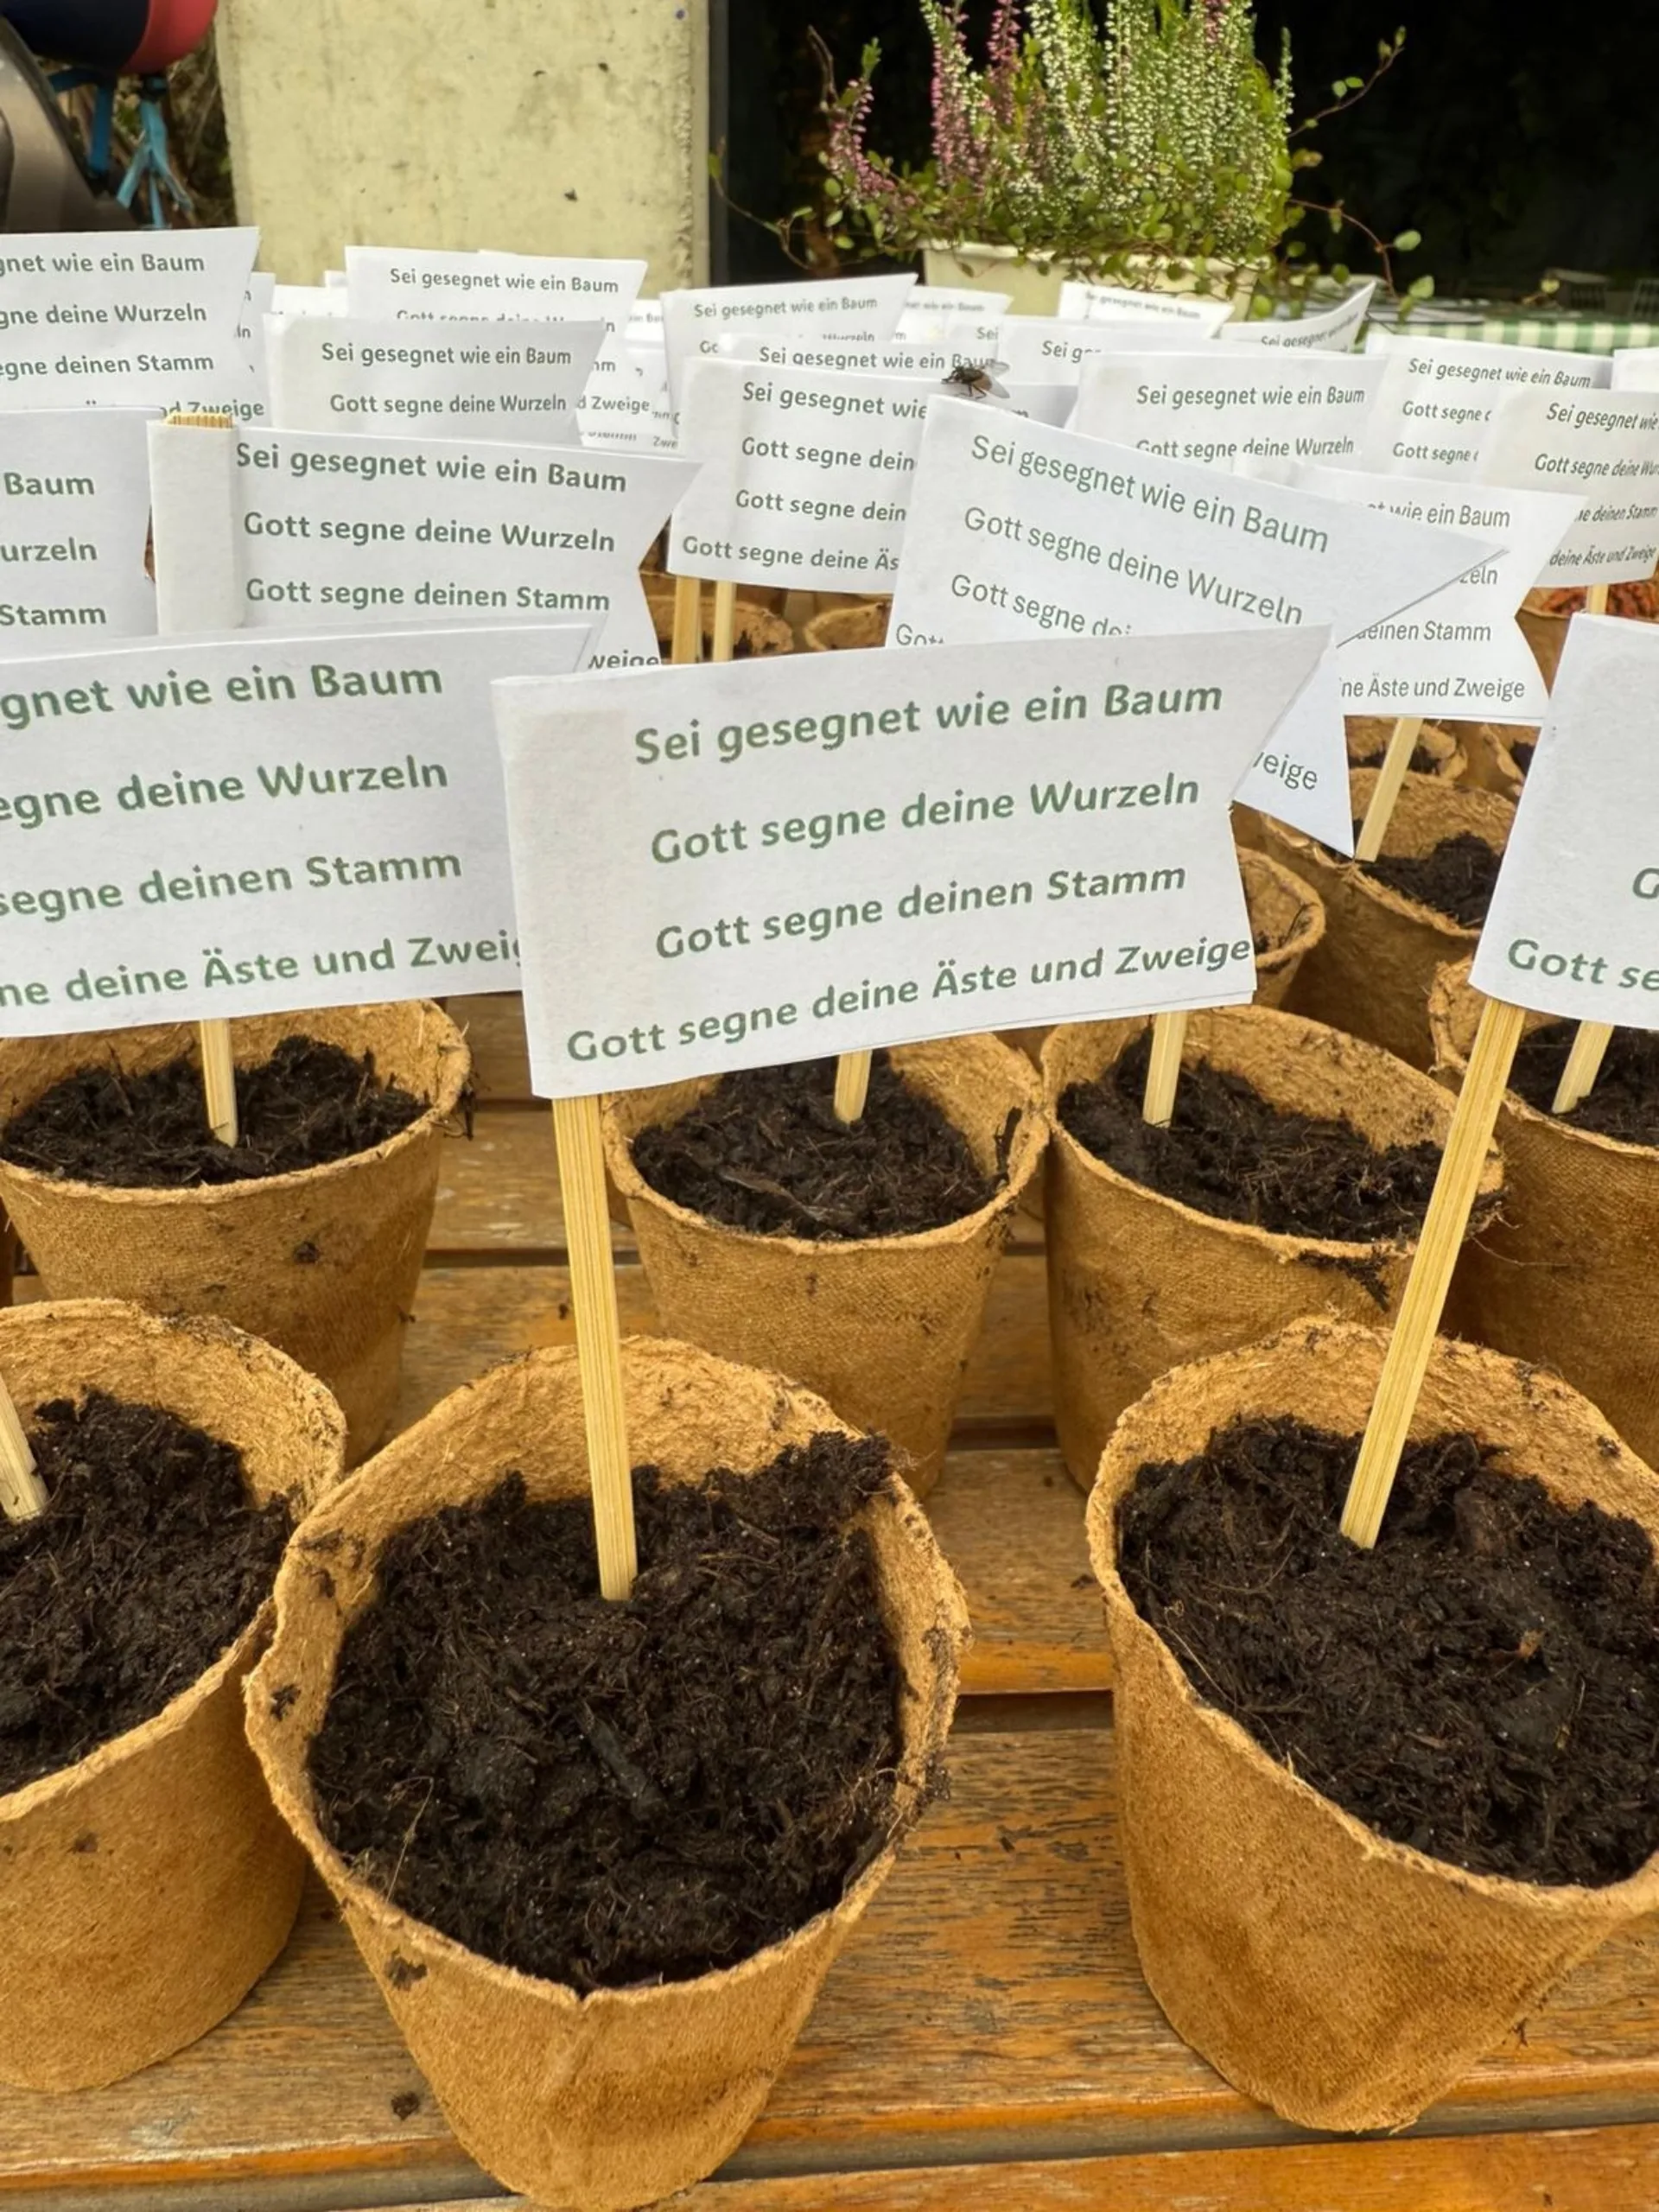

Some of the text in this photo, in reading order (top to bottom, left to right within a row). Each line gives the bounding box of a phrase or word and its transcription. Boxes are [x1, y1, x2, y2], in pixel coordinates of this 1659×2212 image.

[51, 252, 93, 272] wie
[99, 252, 135, 272] ein
[141, 253, 205, 272] Baum
[390, 268, 619, 293] Sei gesegnet wie ein Baum
[0, 302, 207, 330] gne deine Wurzeln
[693, 296, 878, 321] Sei gesegnet wie ein Baum
[321, 342, 571, 368] Sei gesegnet wie ein Baum
[759, 346, 786, 365] Sei
[882, 352, 914, 369] wie
[918, 352, 945, 369] ein
[1041, 340, 1069, 358] Sei
[54, 354, 131, 375] deinen
[137, 354, 214, 372] Stamm
[1408, 357, 1592, 389] Sei gesegnet wie ein Baum
[329, 393, 378, 413] Gott
[384, 399, 443, 418] segne
[448, 394, 496, 413] deine
[499, 393, 567, 412] Wurzeln
[590, 396, 651, 416] Zweige
[742, 381, 773, 402] Sei
[779, 389, 885, 416] gesegnet
[1136, 384, 1365, 410] Sei gesegnet wie ein Baum
[1402, 400, 1439, 419] Gott
[1440, 407, 1483, 425] segne
[1546, 402, 1658, 432] Sei gesegnet wie
[741, 435, 915, 471] Gott segne dein
[1183, 442, 1237, 464] segne
[1295, 435, 1354, 456] Wurzeln
[1392, 442, 1429, 460] Gott
[1431, 448, 1471, 466] segne
[236, 442, 626, 493] Sei gesegnet wie ein Baum
[1534, 453, 1570, 474] Gott
[1570, 461, 1610, 480] segne
[1611, 459, 1641, 477] deine
[3, 472, 95, 496] Baum
[971, 435, 1328, 554] Sei gesegnet wie ein Baum
[735, 488, 906, 522] Gott segne dein
[1426, 502, 1455, 524] ein
[1459, 504, 1510, 528] Baum
[244, 511, 614, 552] Gott segne deine Wurzeln
[0, 537, 98, 563] urzeln
[682, 536, 899, 571] Gott segne deine Äs
[964, 506, 1302, 626] Gott segne deine Wurzeln
[245, 577, 610, 611] Gott segne deinen Stamm
[951, 574, 1008, 608] Gott
[1012, 594, 1086, 633] segne
[0, 604, 107, 626] Stamm
[1423, 620, 1491, 641] Stamm
[0, 664, 442, 731] gnet wie ein Baum
[1367, 671, 1409, 697] Äste
[1414, 677, 1450, 697] und
[1452, 677, 1525, 702] Zweige
[635, 683, 1223, 766] Sei gesegnet wie ein Baum
[0, 754, 448, 830] egne deine Wurzeln
[651, 772, 1198, 864] Gott segne deine Wurzeln
[138, 864, 293, 905] deinen
[306, 854, 462, 888] Stamm
[656, 868, 1185, 959] Gott segne deinen Stamm
[65, 964, 188, 1001] deine
[202, 946, 300, 988] Äste
[313, 938, 396, 976] und
[407, 929, 521, 968] Zwei
[1508, 938, 1610, 985] Gott
[567, 936, 1250, 1062] Gott segne deine Äste und Zweige
